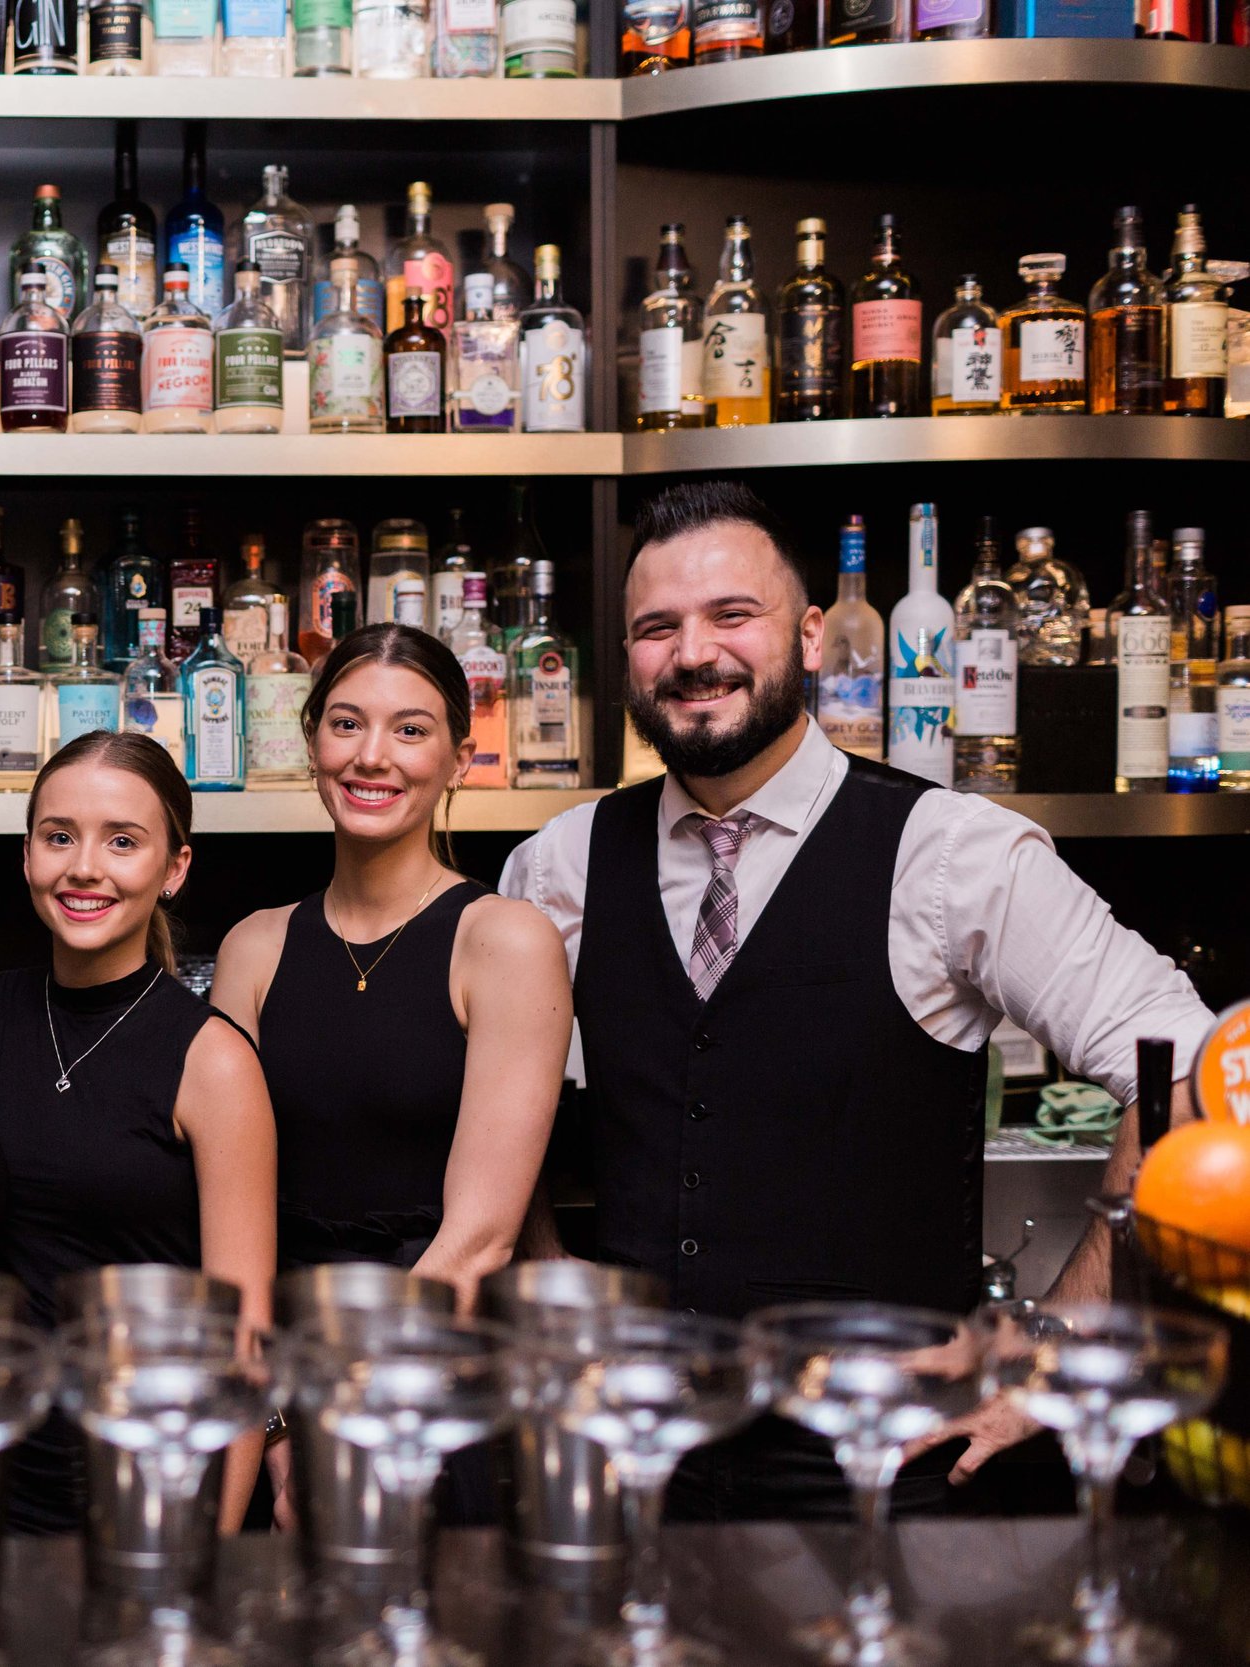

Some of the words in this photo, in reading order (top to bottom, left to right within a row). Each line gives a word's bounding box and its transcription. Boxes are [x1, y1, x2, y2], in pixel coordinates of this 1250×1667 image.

[15, 0, 65, 49] GIN
[4, 359, 23, 370] FOUR
[24, 358, 58, 370] PILLARS
[158, 356, 177, 367] FOUR
[225, 355, 245, 367] FOUR
[246, 354, 279, 367] PILLARS
[1123, 630, 1169, 651] 666
[72, 710, 111, 718] PATIENT
[79, 717, 106, 725] WOLF
